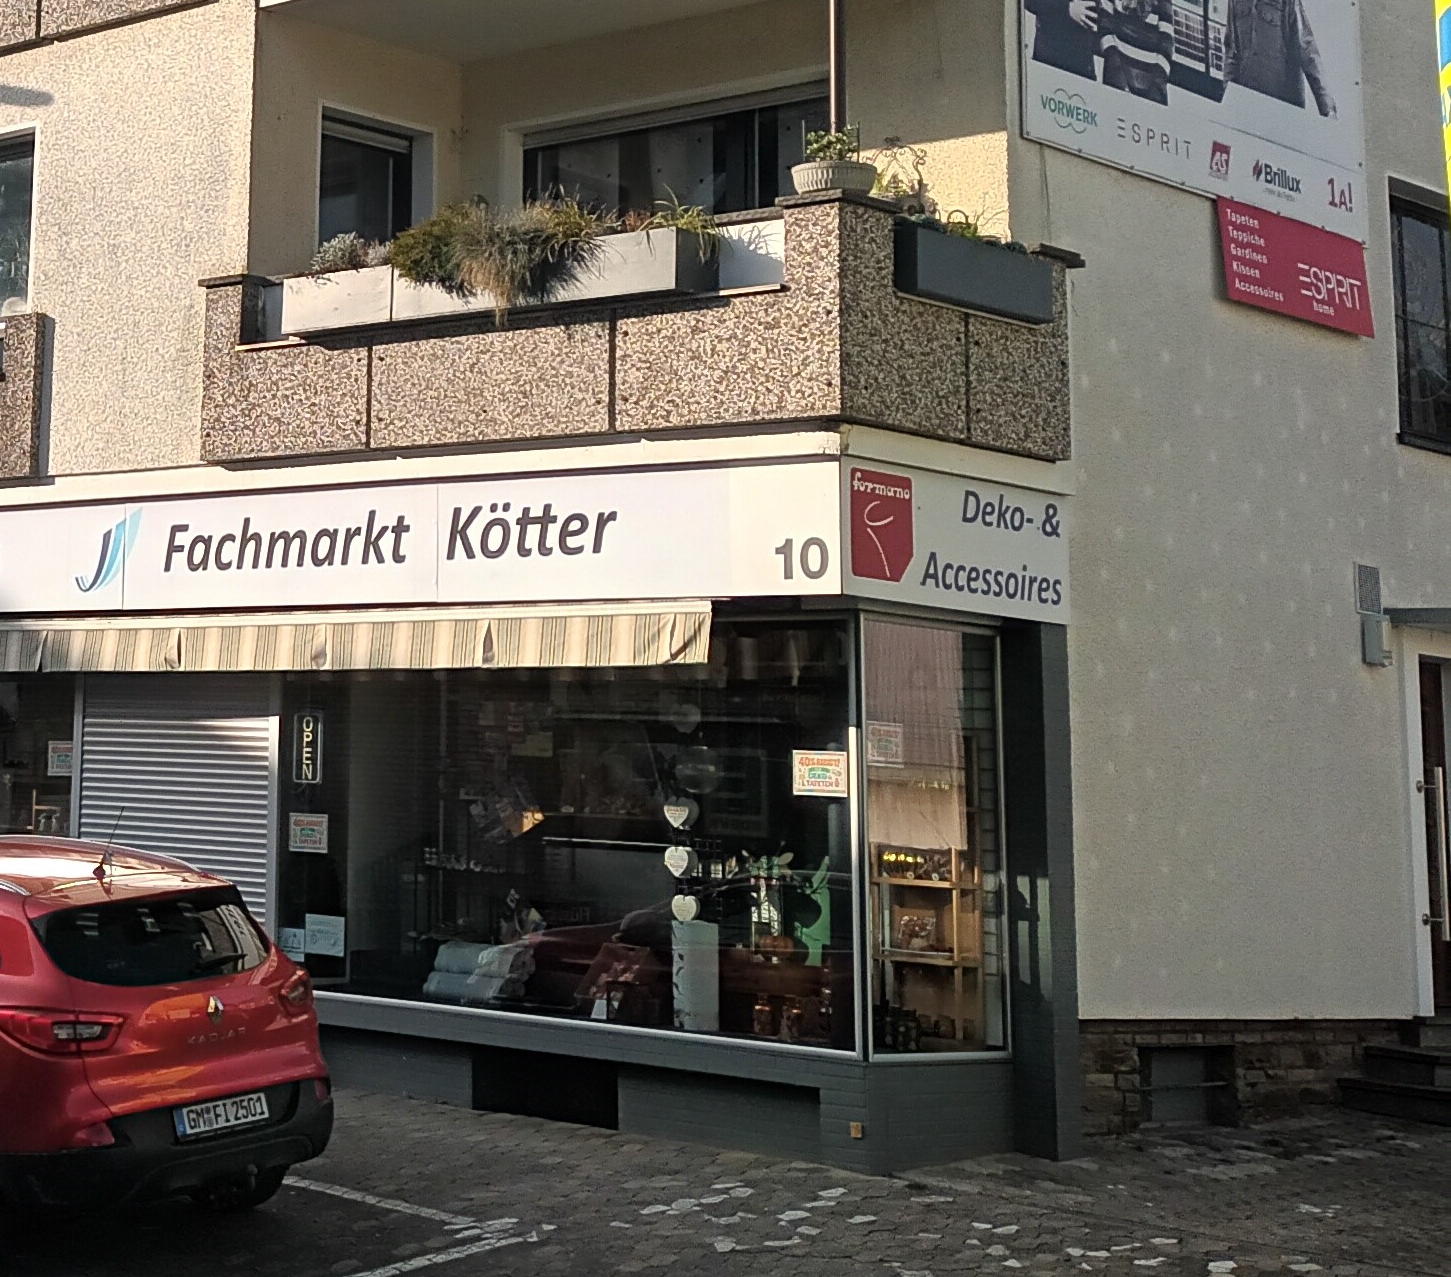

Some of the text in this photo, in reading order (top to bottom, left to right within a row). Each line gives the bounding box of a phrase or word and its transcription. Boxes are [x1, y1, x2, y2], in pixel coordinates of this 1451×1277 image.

[1041, 94, 1098, 127] VORWERK
[1117, 117, 1192, 159] ESPRIT
[1263, 163, 1302, 194] Brillux
[1226, 208, 1259, 229] Tapeten
[1228, 226, 1266, 247] Teppiche
[1230, 243, 1268, 264] Gardinen
[1232, 260, 1260, 279] Kissen
[1235, 277, 1284, 302] Accessoires
[1297, 262, 1361, 310] ESPRIT
[1313, 300, 1335, 316] home
[852, 471, 910, 500] formano
[962, 489, 1061, 538] Deko- &
[163, 502, 617, 573] Fachmarkt Kötter
[774, 536, 829, 580] 10
[919, 551, 1062, 605] Accessoires
[302, 716, 313, 780] OPEN
[186, 1095, 266, 1130] GM FI 2501
